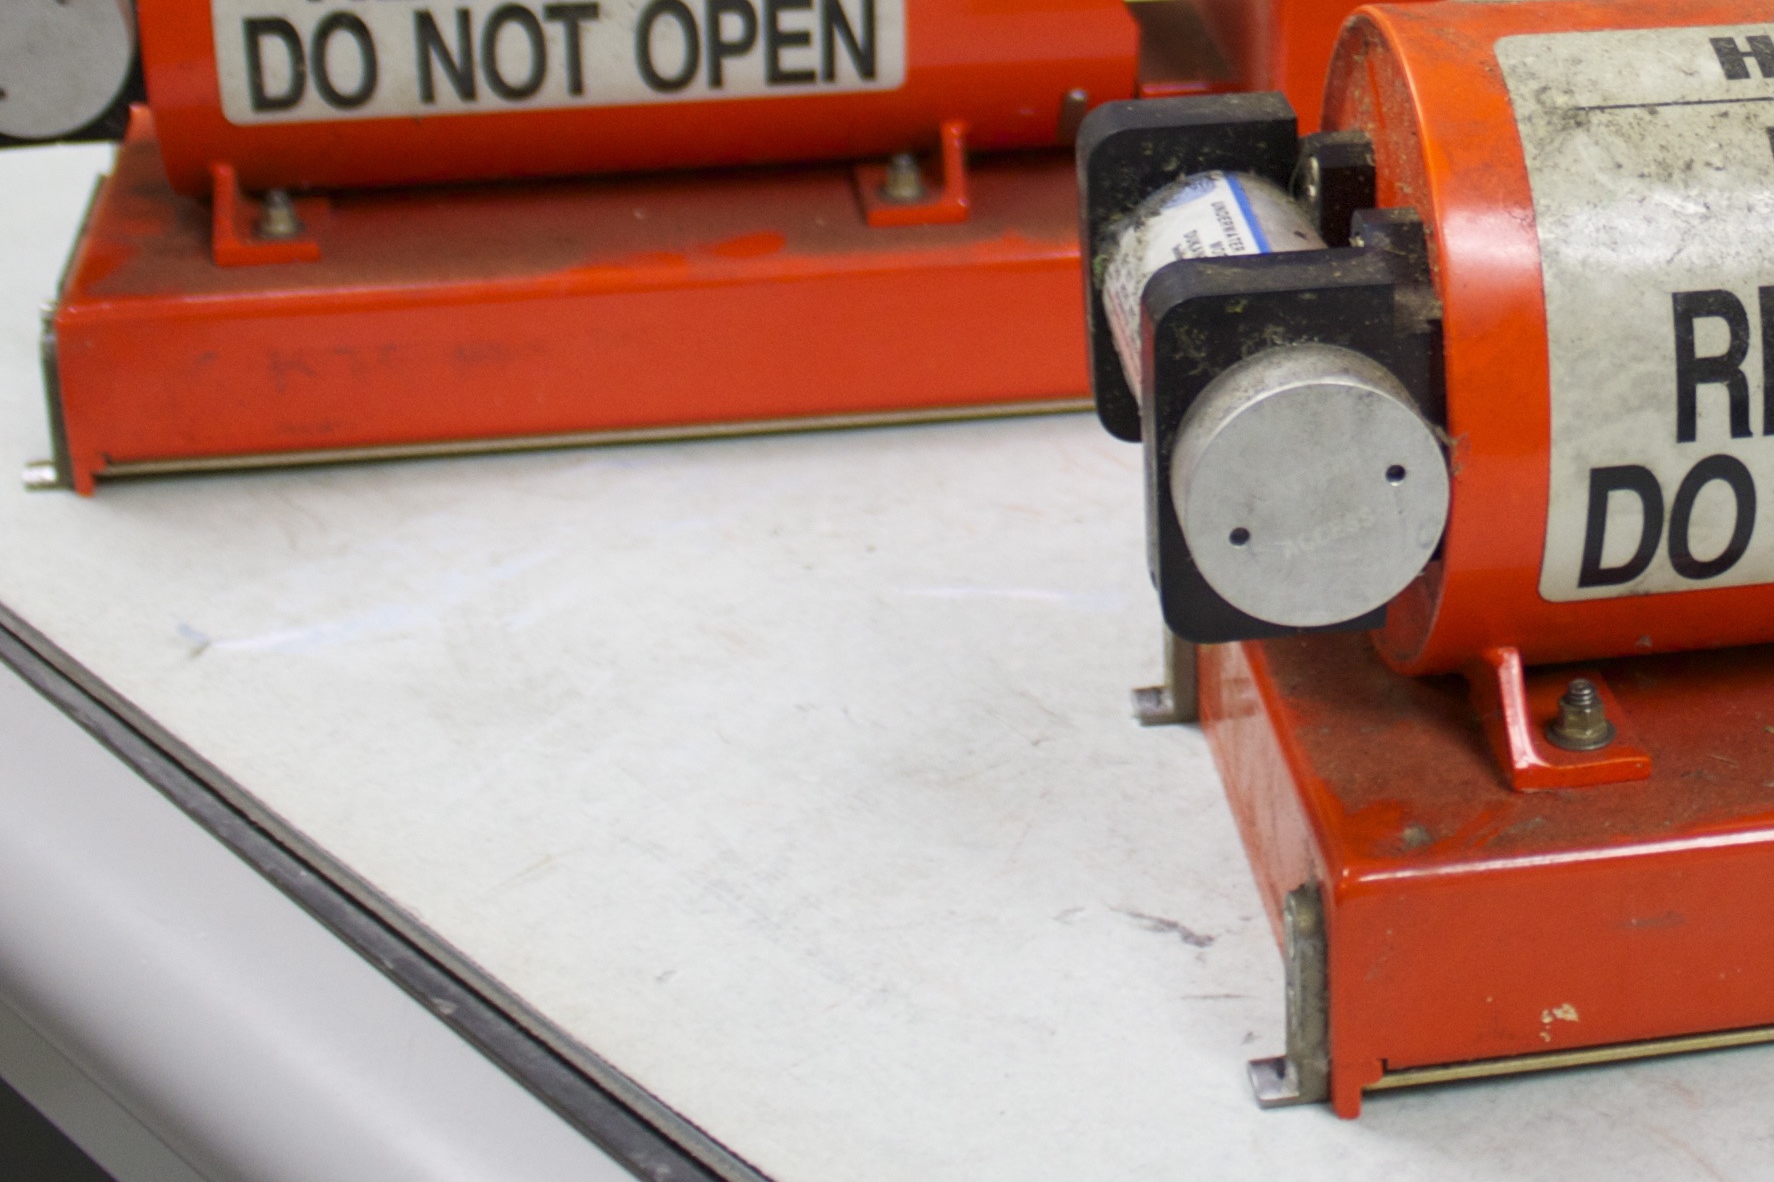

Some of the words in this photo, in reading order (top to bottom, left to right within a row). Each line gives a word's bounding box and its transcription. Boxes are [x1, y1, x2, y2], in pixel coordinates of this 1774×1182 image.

[243, 12, 378, 113] DO
[413, 2, 601, 104] NOT
[1211, 201, 1246, 253] UNDERWATER
[1577, 454, 1757, 588] DO
